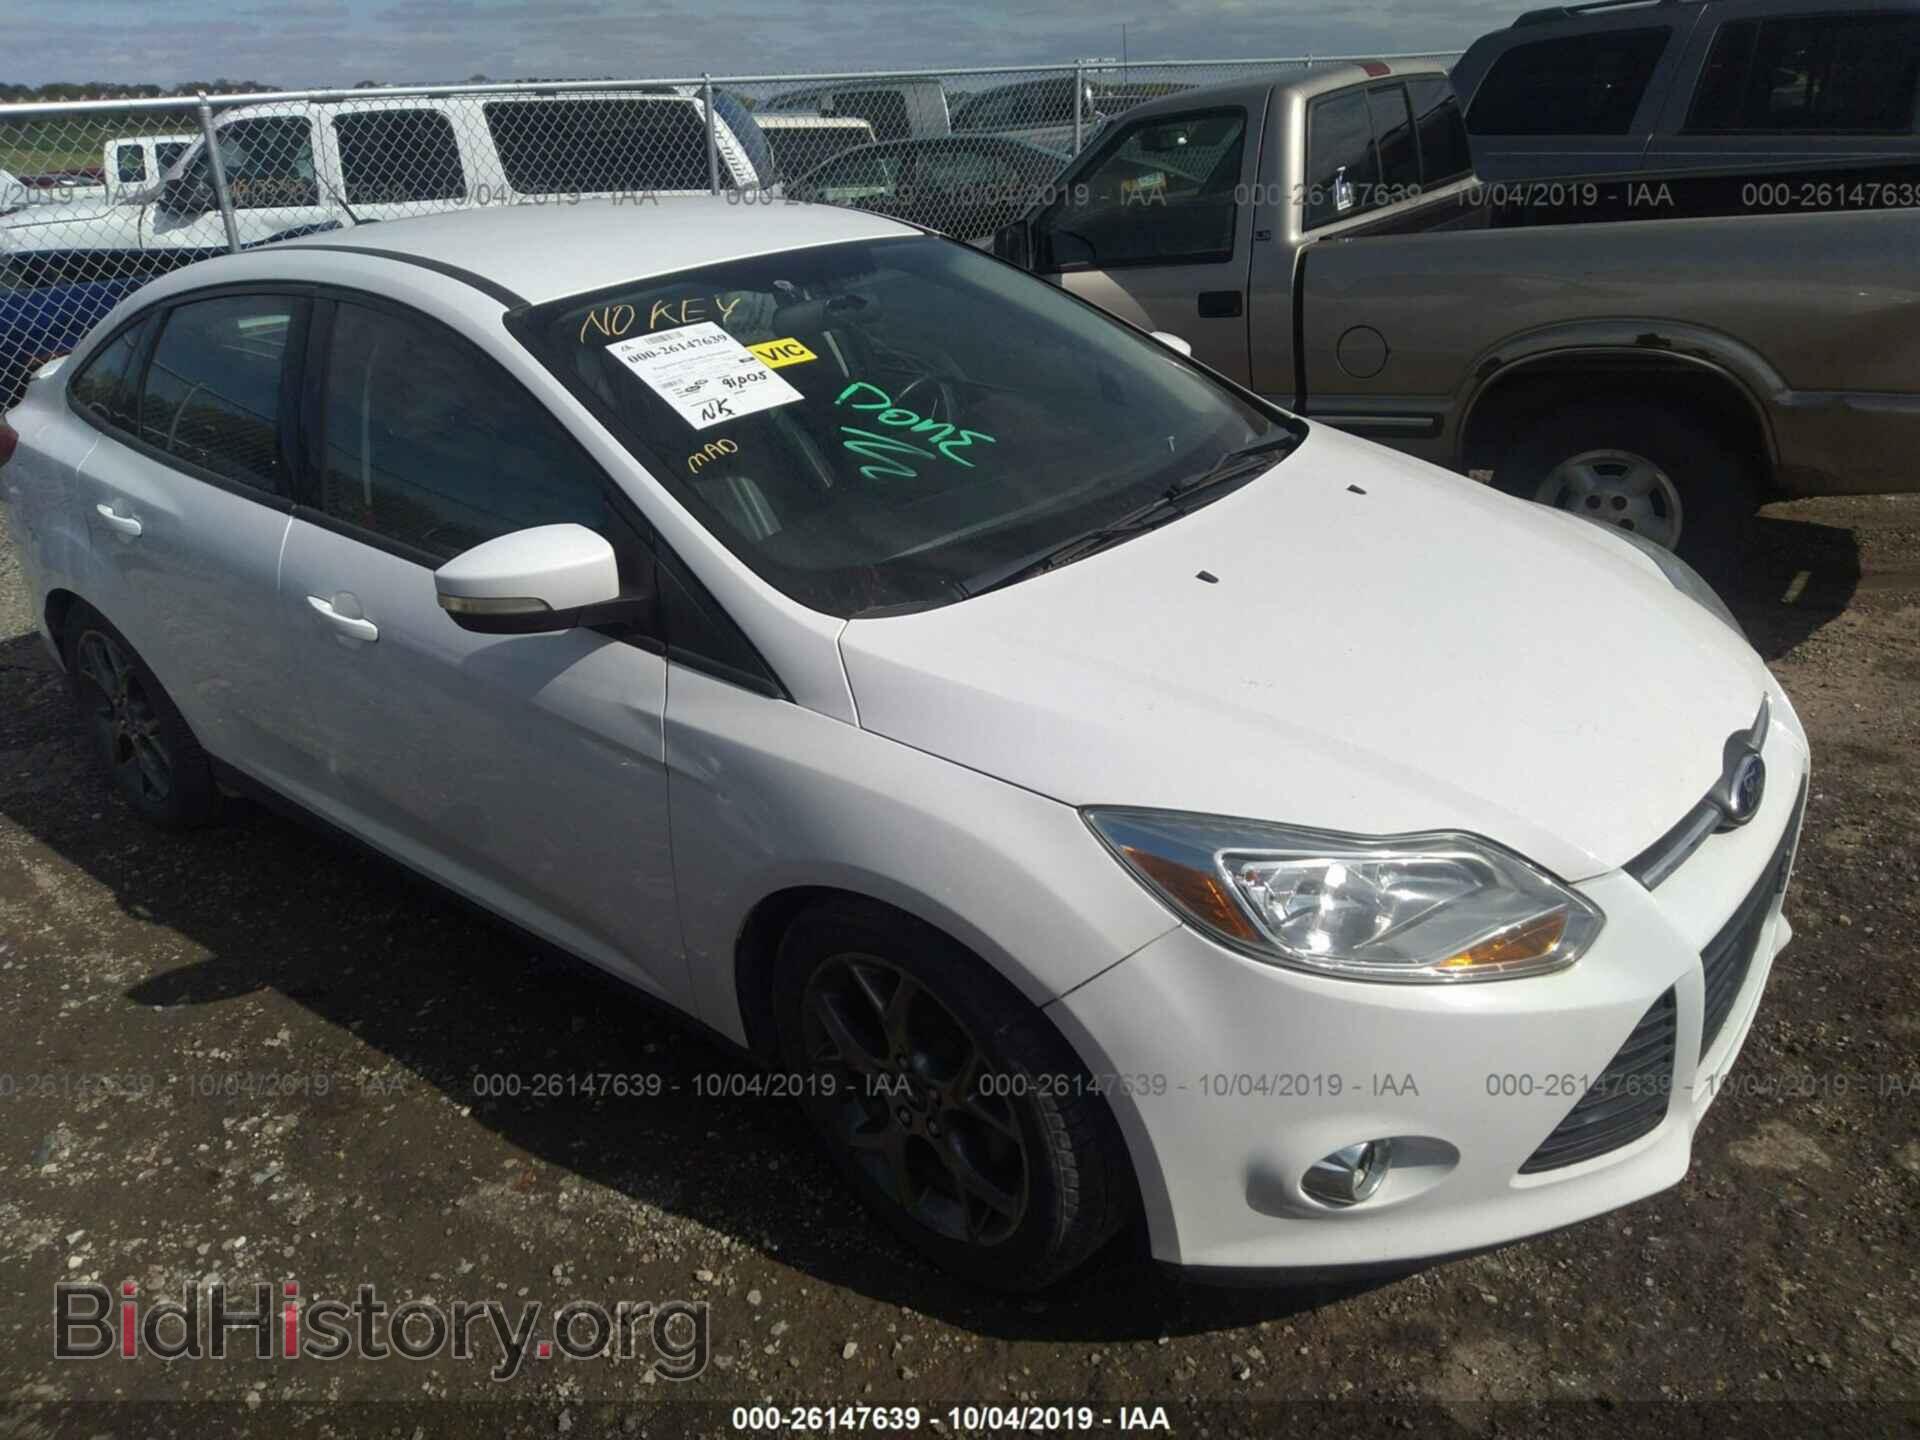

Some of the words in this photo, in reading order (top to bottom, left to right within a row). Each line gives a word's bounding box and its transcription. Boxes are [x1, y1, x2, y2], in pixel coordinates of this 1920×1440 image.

[580, 303, 636, 344] NO
[650, 294, 741, 329] KEY
[626, 332, 729, 364] 000-26147639
[756, 343, 807, 363] VIC
